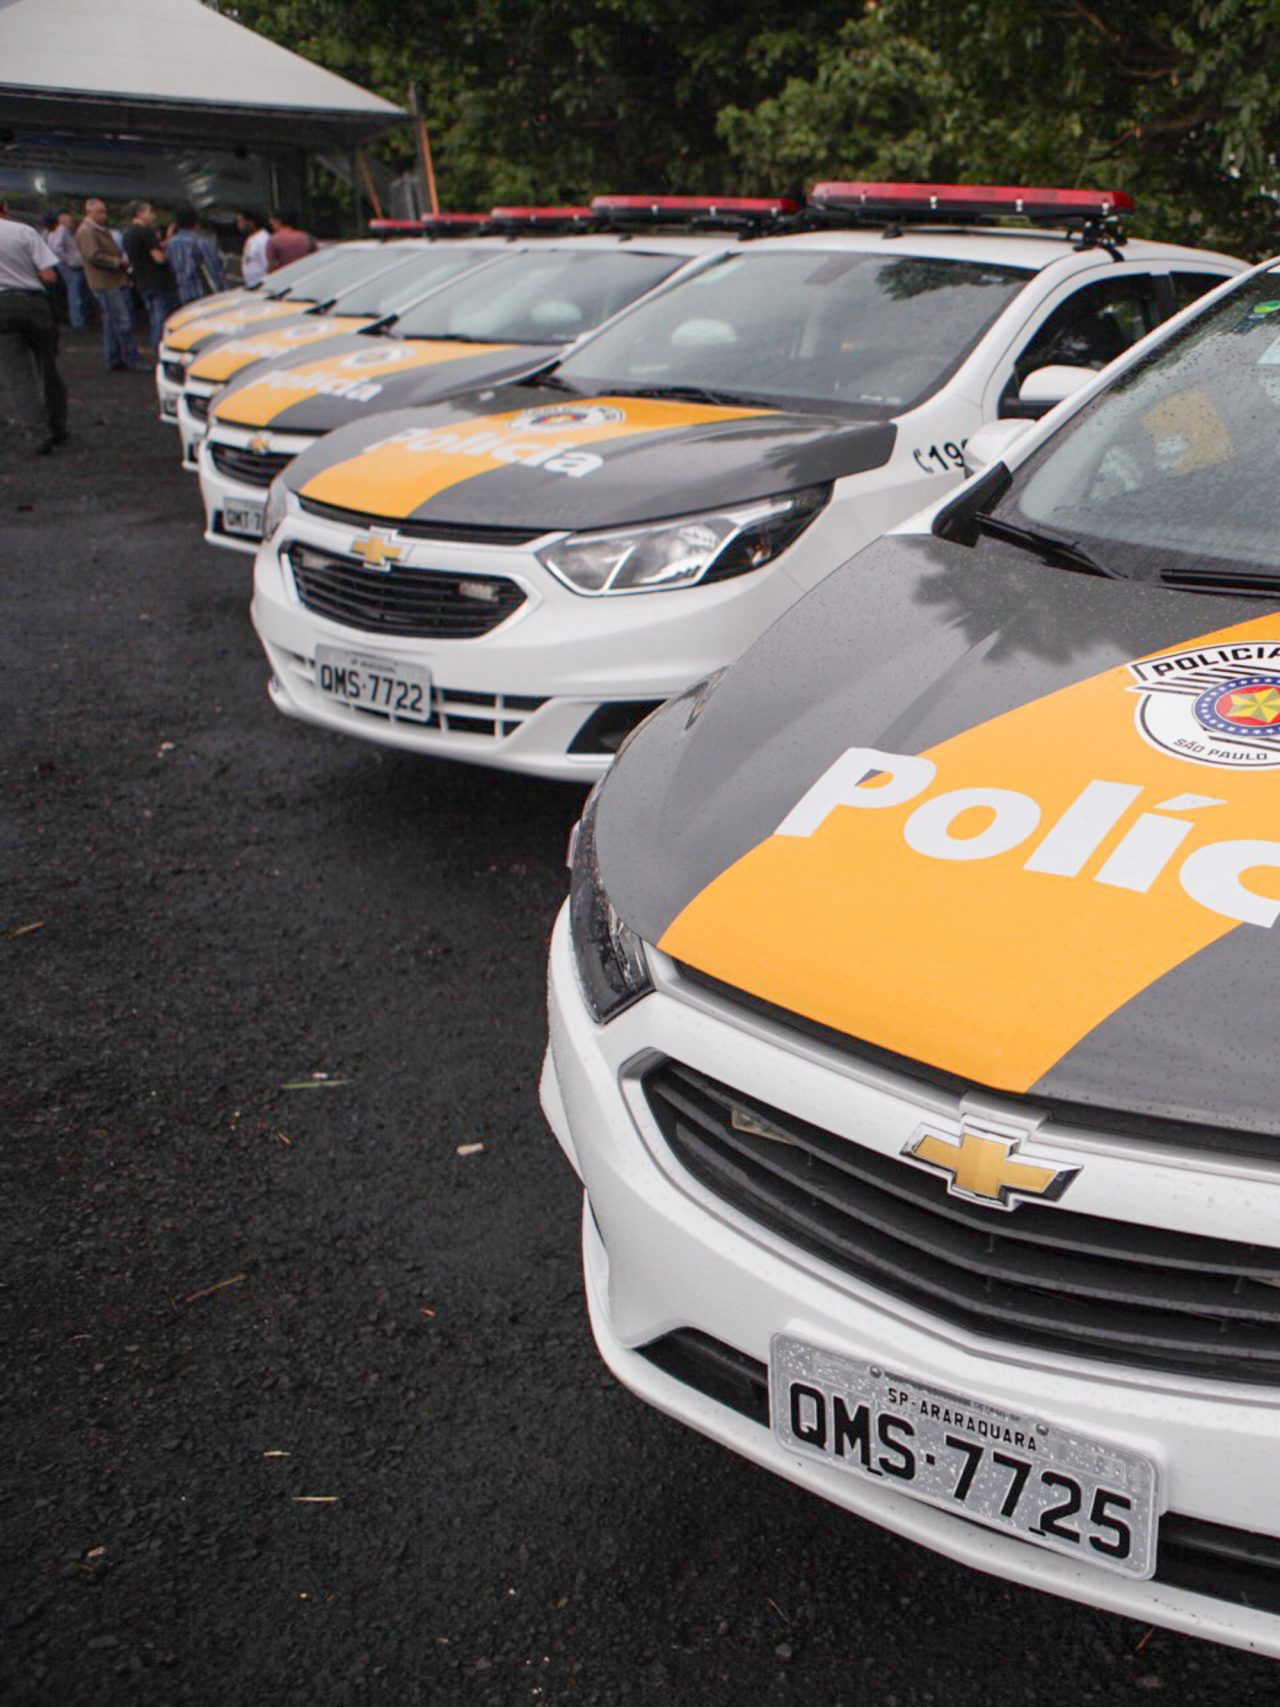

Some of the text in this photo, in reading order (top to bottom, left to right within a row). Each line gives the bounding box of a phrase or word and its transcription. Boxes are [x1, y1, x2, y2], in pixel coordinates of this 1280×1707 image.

[928, 438, 969, 471] 19
[1174, 736, 1268, 761] SÃO PAULO
